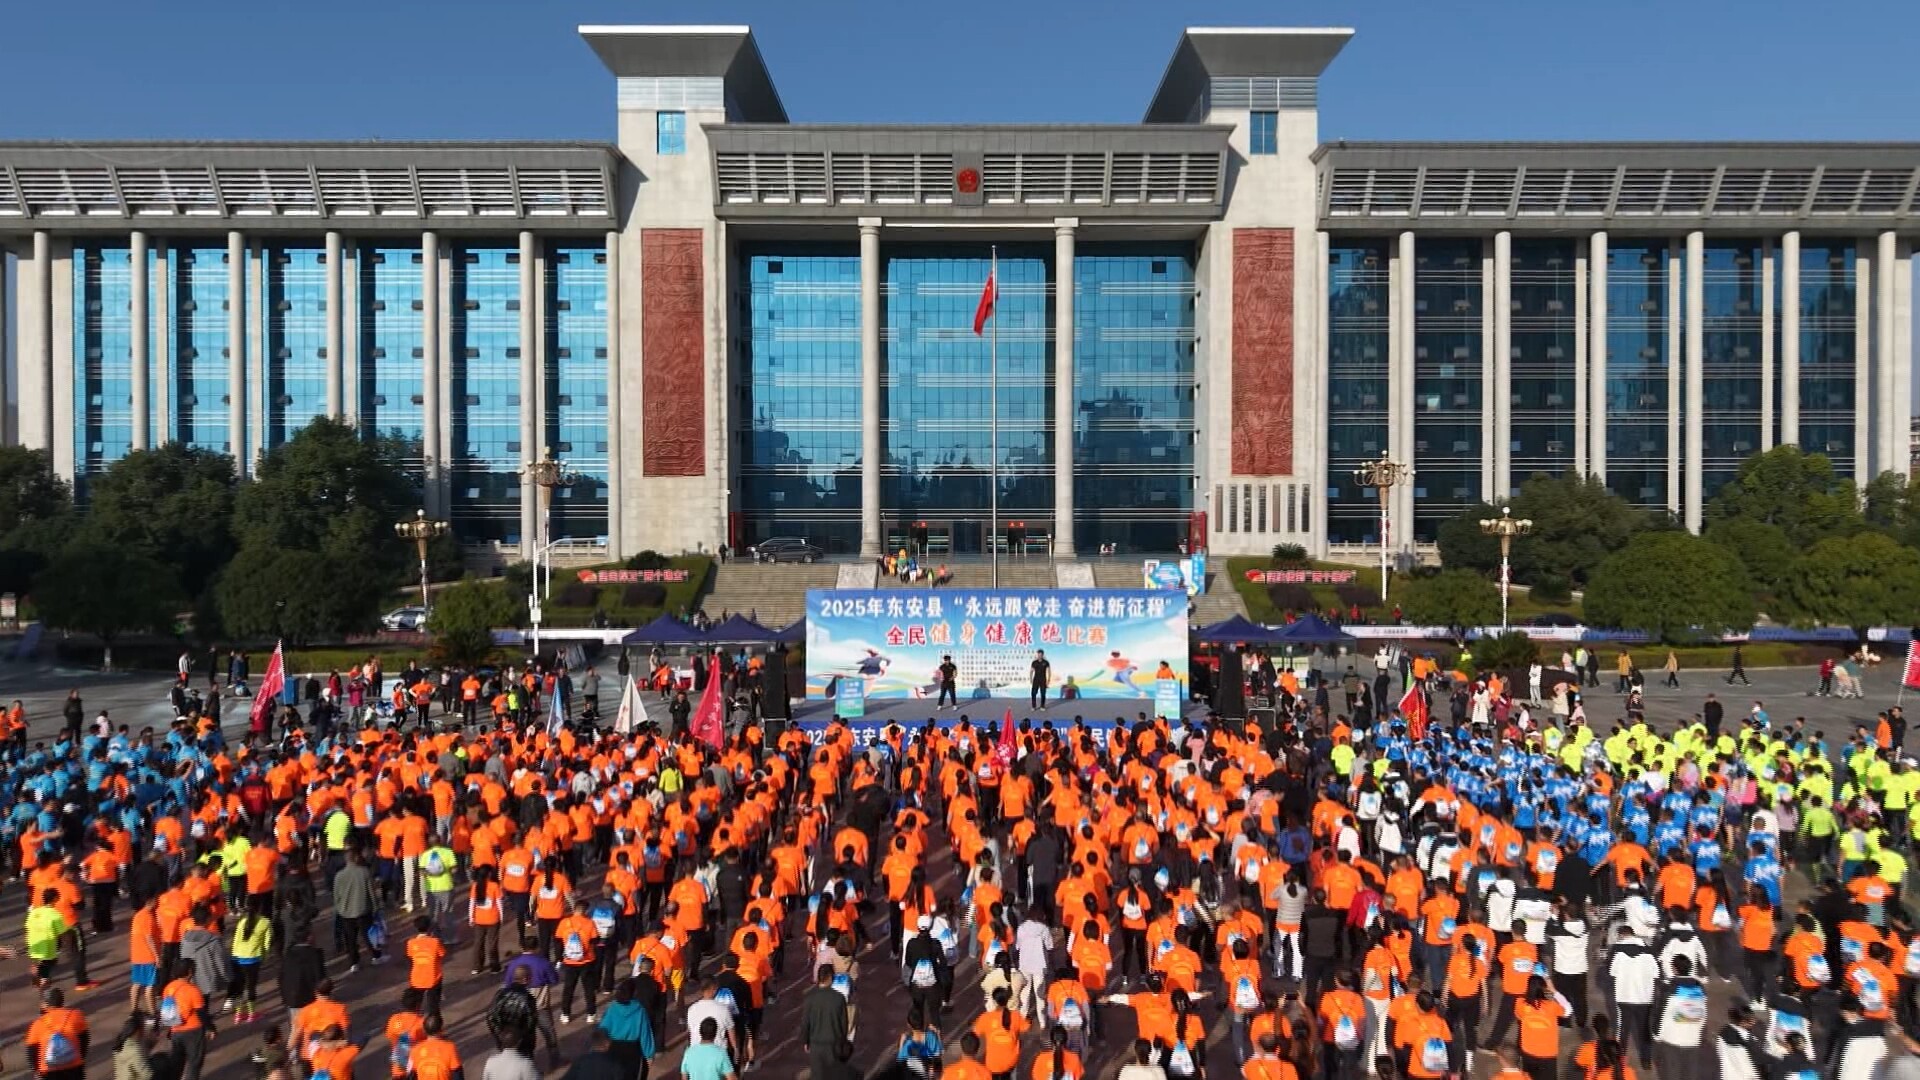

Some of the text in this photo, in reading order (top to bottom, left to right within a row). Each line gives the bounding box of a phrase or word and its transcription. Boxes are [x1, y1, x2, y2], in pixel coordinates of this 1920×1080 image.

[887, 621, 1108, 646] 全民健身健康跑比赛
